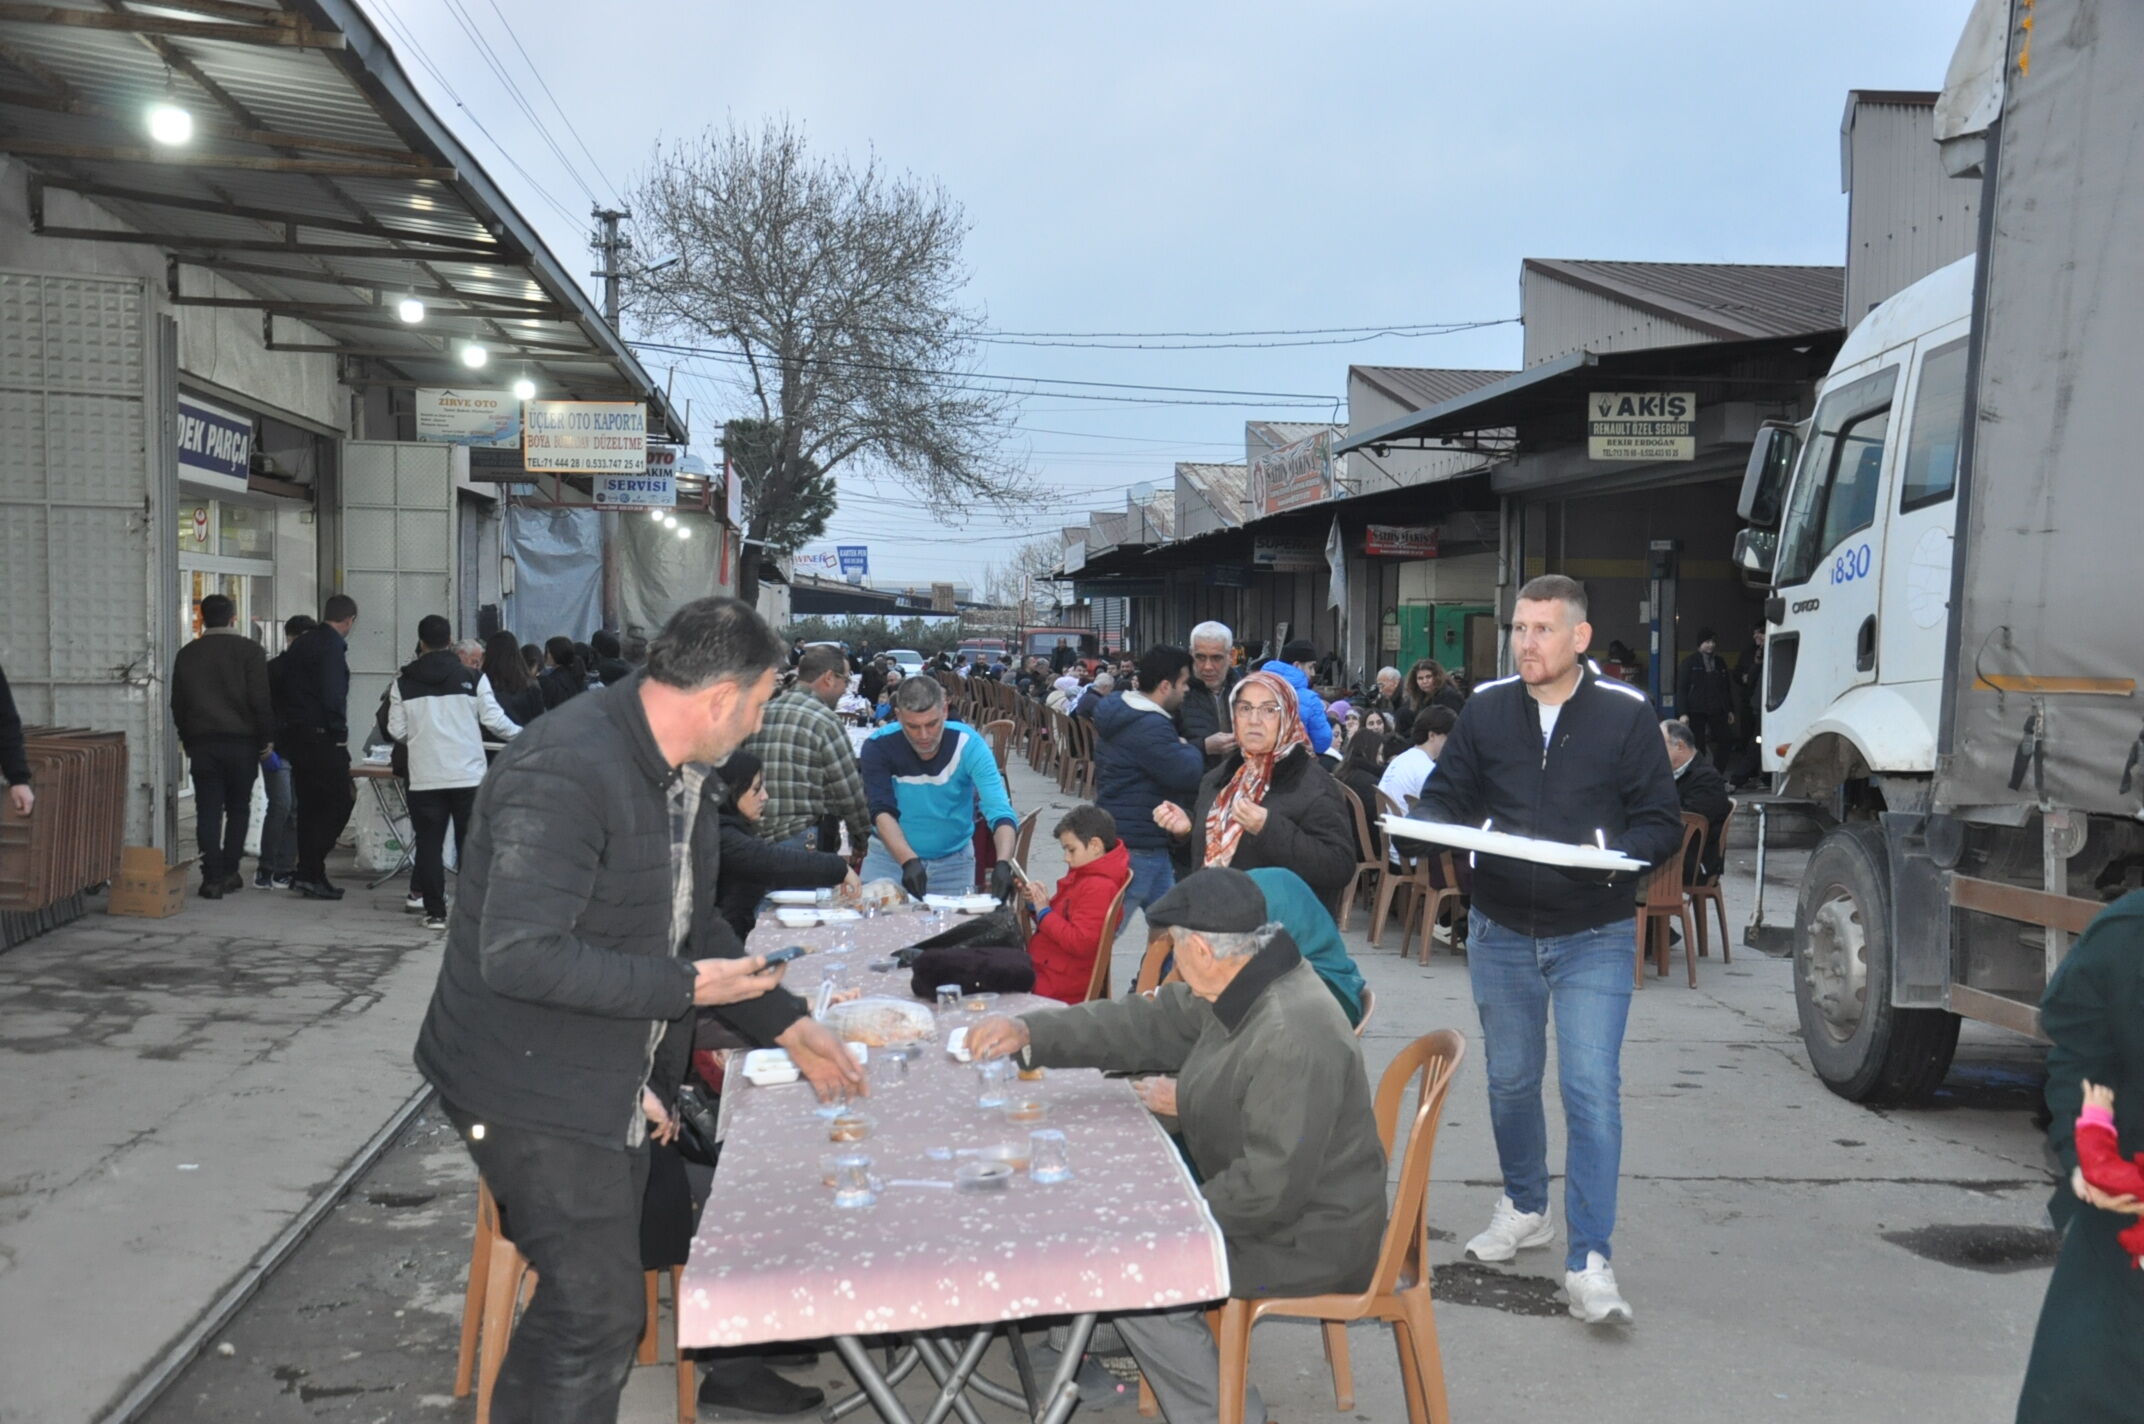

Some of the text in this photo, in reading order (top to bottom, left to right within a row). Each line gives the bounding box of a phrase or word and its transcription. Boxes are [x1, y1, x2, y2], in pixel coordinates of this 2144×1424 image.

[438, 397, 498, 408] ZİRVE OTO
[529, 408, 644, 433] ÜÇLER OTO KAPORTA
[1593, 421, 1689, 434] RENAULT ÖZEL SERVİSİ
[206, 423, 248, 472] PARÇA
[528, 435, 550, 449] BOYA
[594, 434, 643, 450] DÜZELTME
[1635, 438, 1675, 446] ERDOĞAN
[528, 458, 552, 467] TEL:71
[555, 458, 569, 467] 444
[571, 458, 580, 467] 28
[586, 459, 622, 468] 0.533.747
[624, 460, 634, 468] 25
[635, 460, 644, 468] 41
[608, 478, 667, 492] SERVİSİ
[1831, 544, 1871, 585] 1830
[1792, 598, 1820, 614] CARGO
